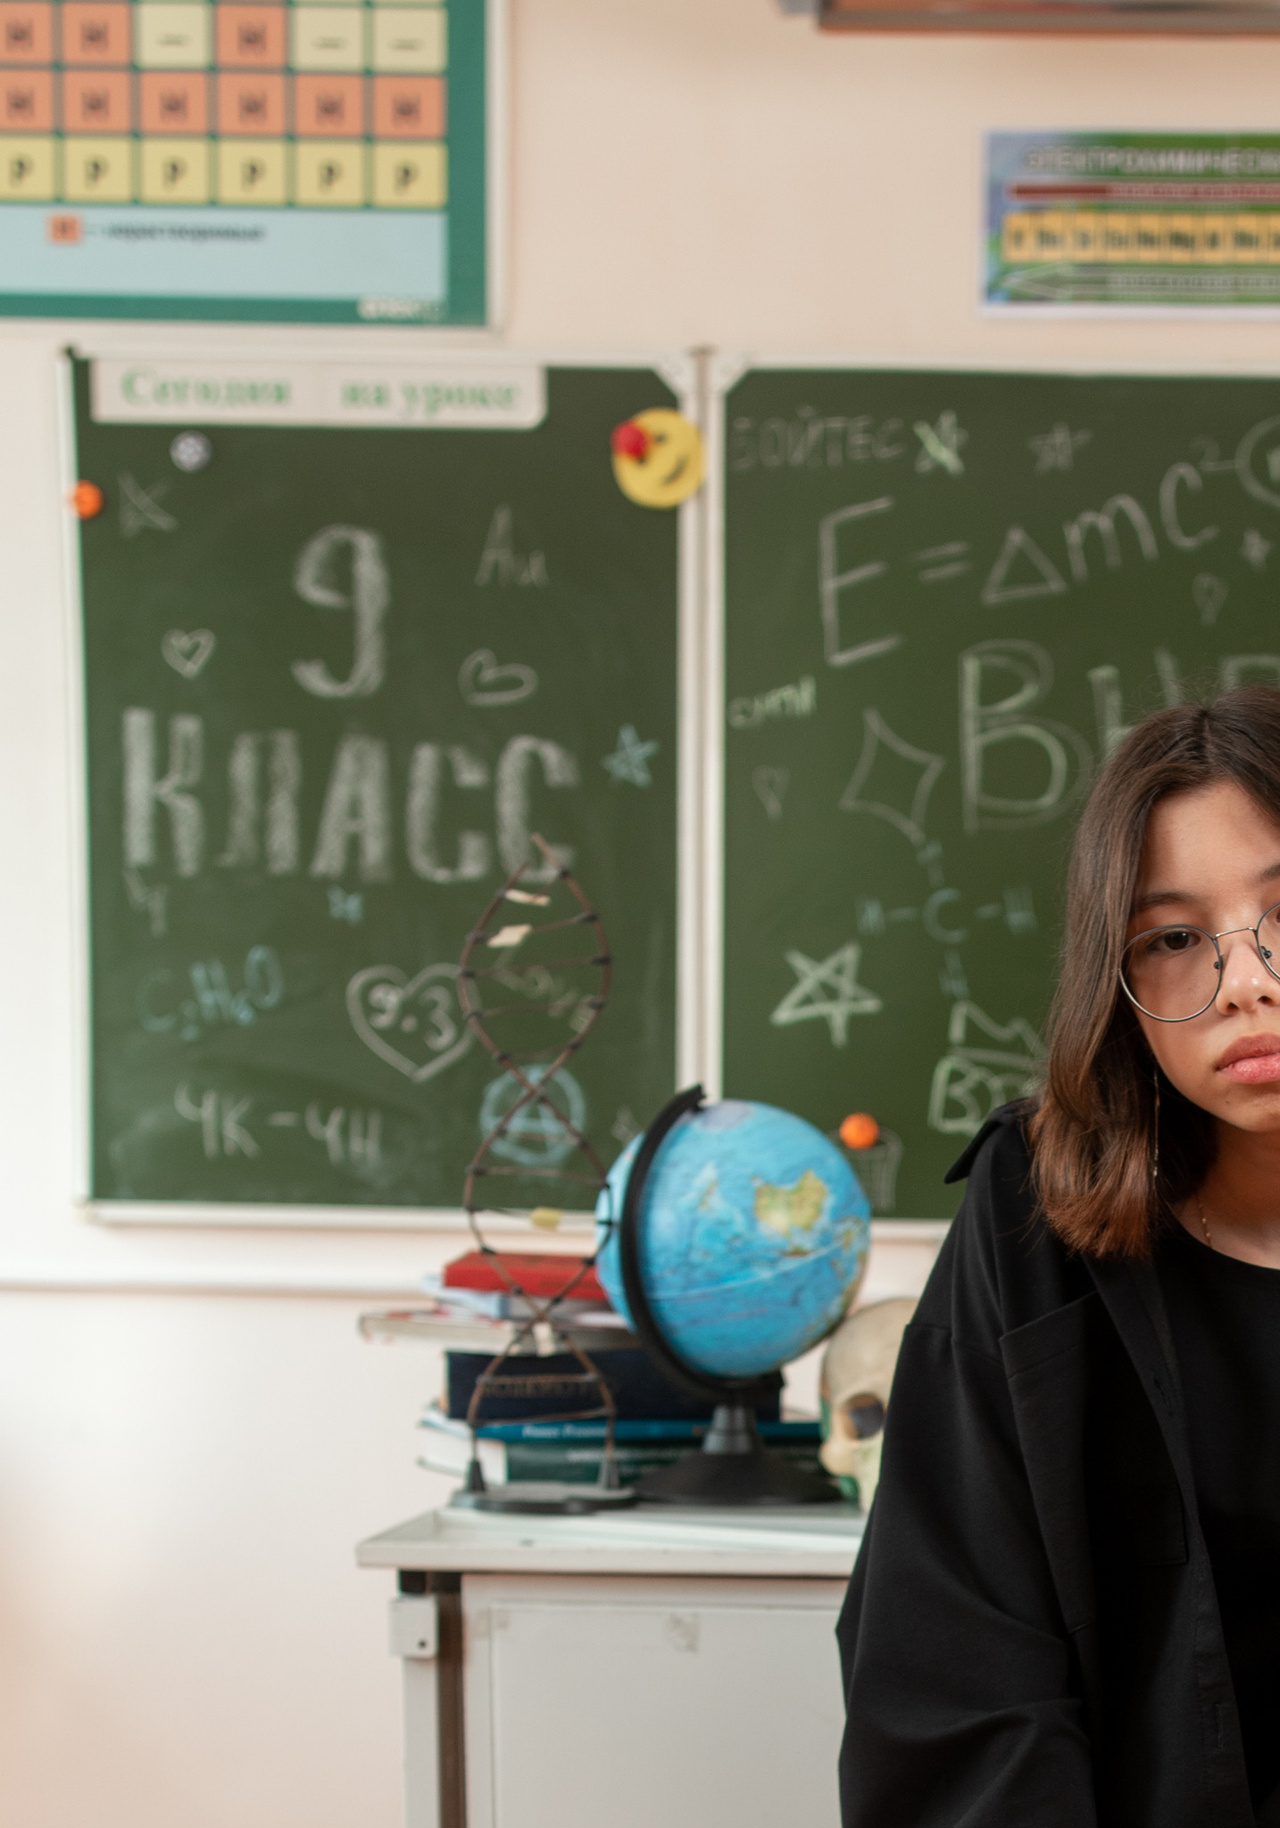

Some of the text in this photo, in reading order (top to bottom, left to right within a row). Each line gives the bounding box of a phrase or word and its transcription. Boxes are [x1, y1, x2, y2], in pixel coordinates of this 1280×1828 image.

[121, 367, 519, 420] Сегодня на уроке
[289, 522, 392, 698] 9
[121, 704, 580, 884] КЛАСС
